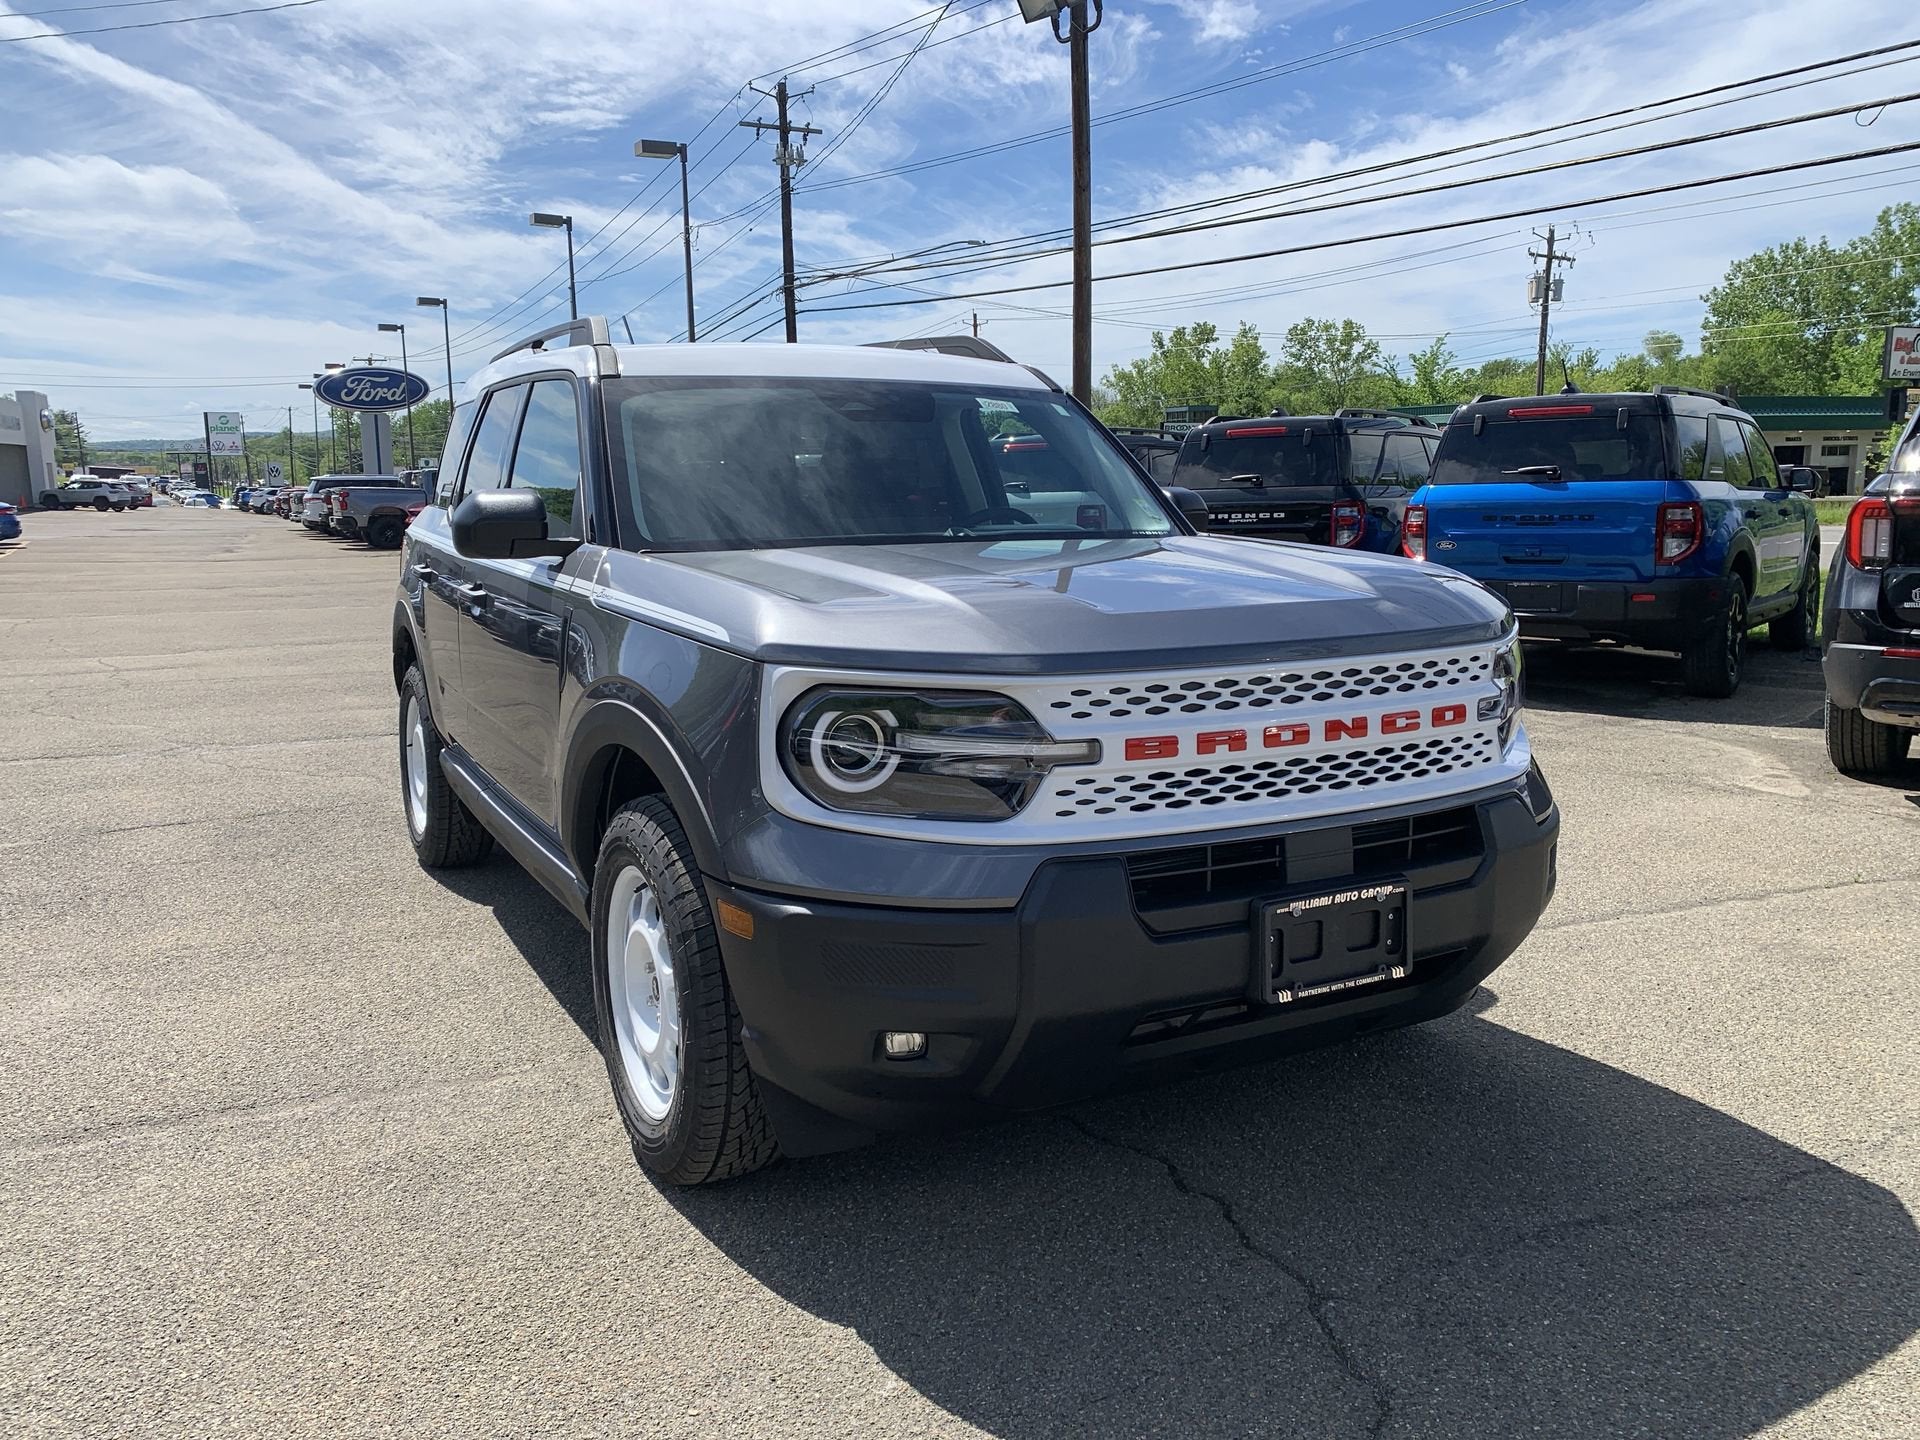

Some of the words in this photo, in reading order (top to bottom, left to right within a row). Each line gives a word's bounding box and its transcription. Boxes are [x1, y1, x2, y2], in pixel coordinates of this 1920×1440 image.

[340, 375, 407, 402] Ford
[210, 425, 239, 433] planet
[1125, 704, 1466, 761] BRONCO
[1334, 891, 1359, 904] AUTO
[1298, 986, 1330, 998] PARTNERING
[1331, 983, 1345, 991] WITH
[1345, 980, 1356, 988] THE
[1355, 974, 1386, 986] COMMUNITY
